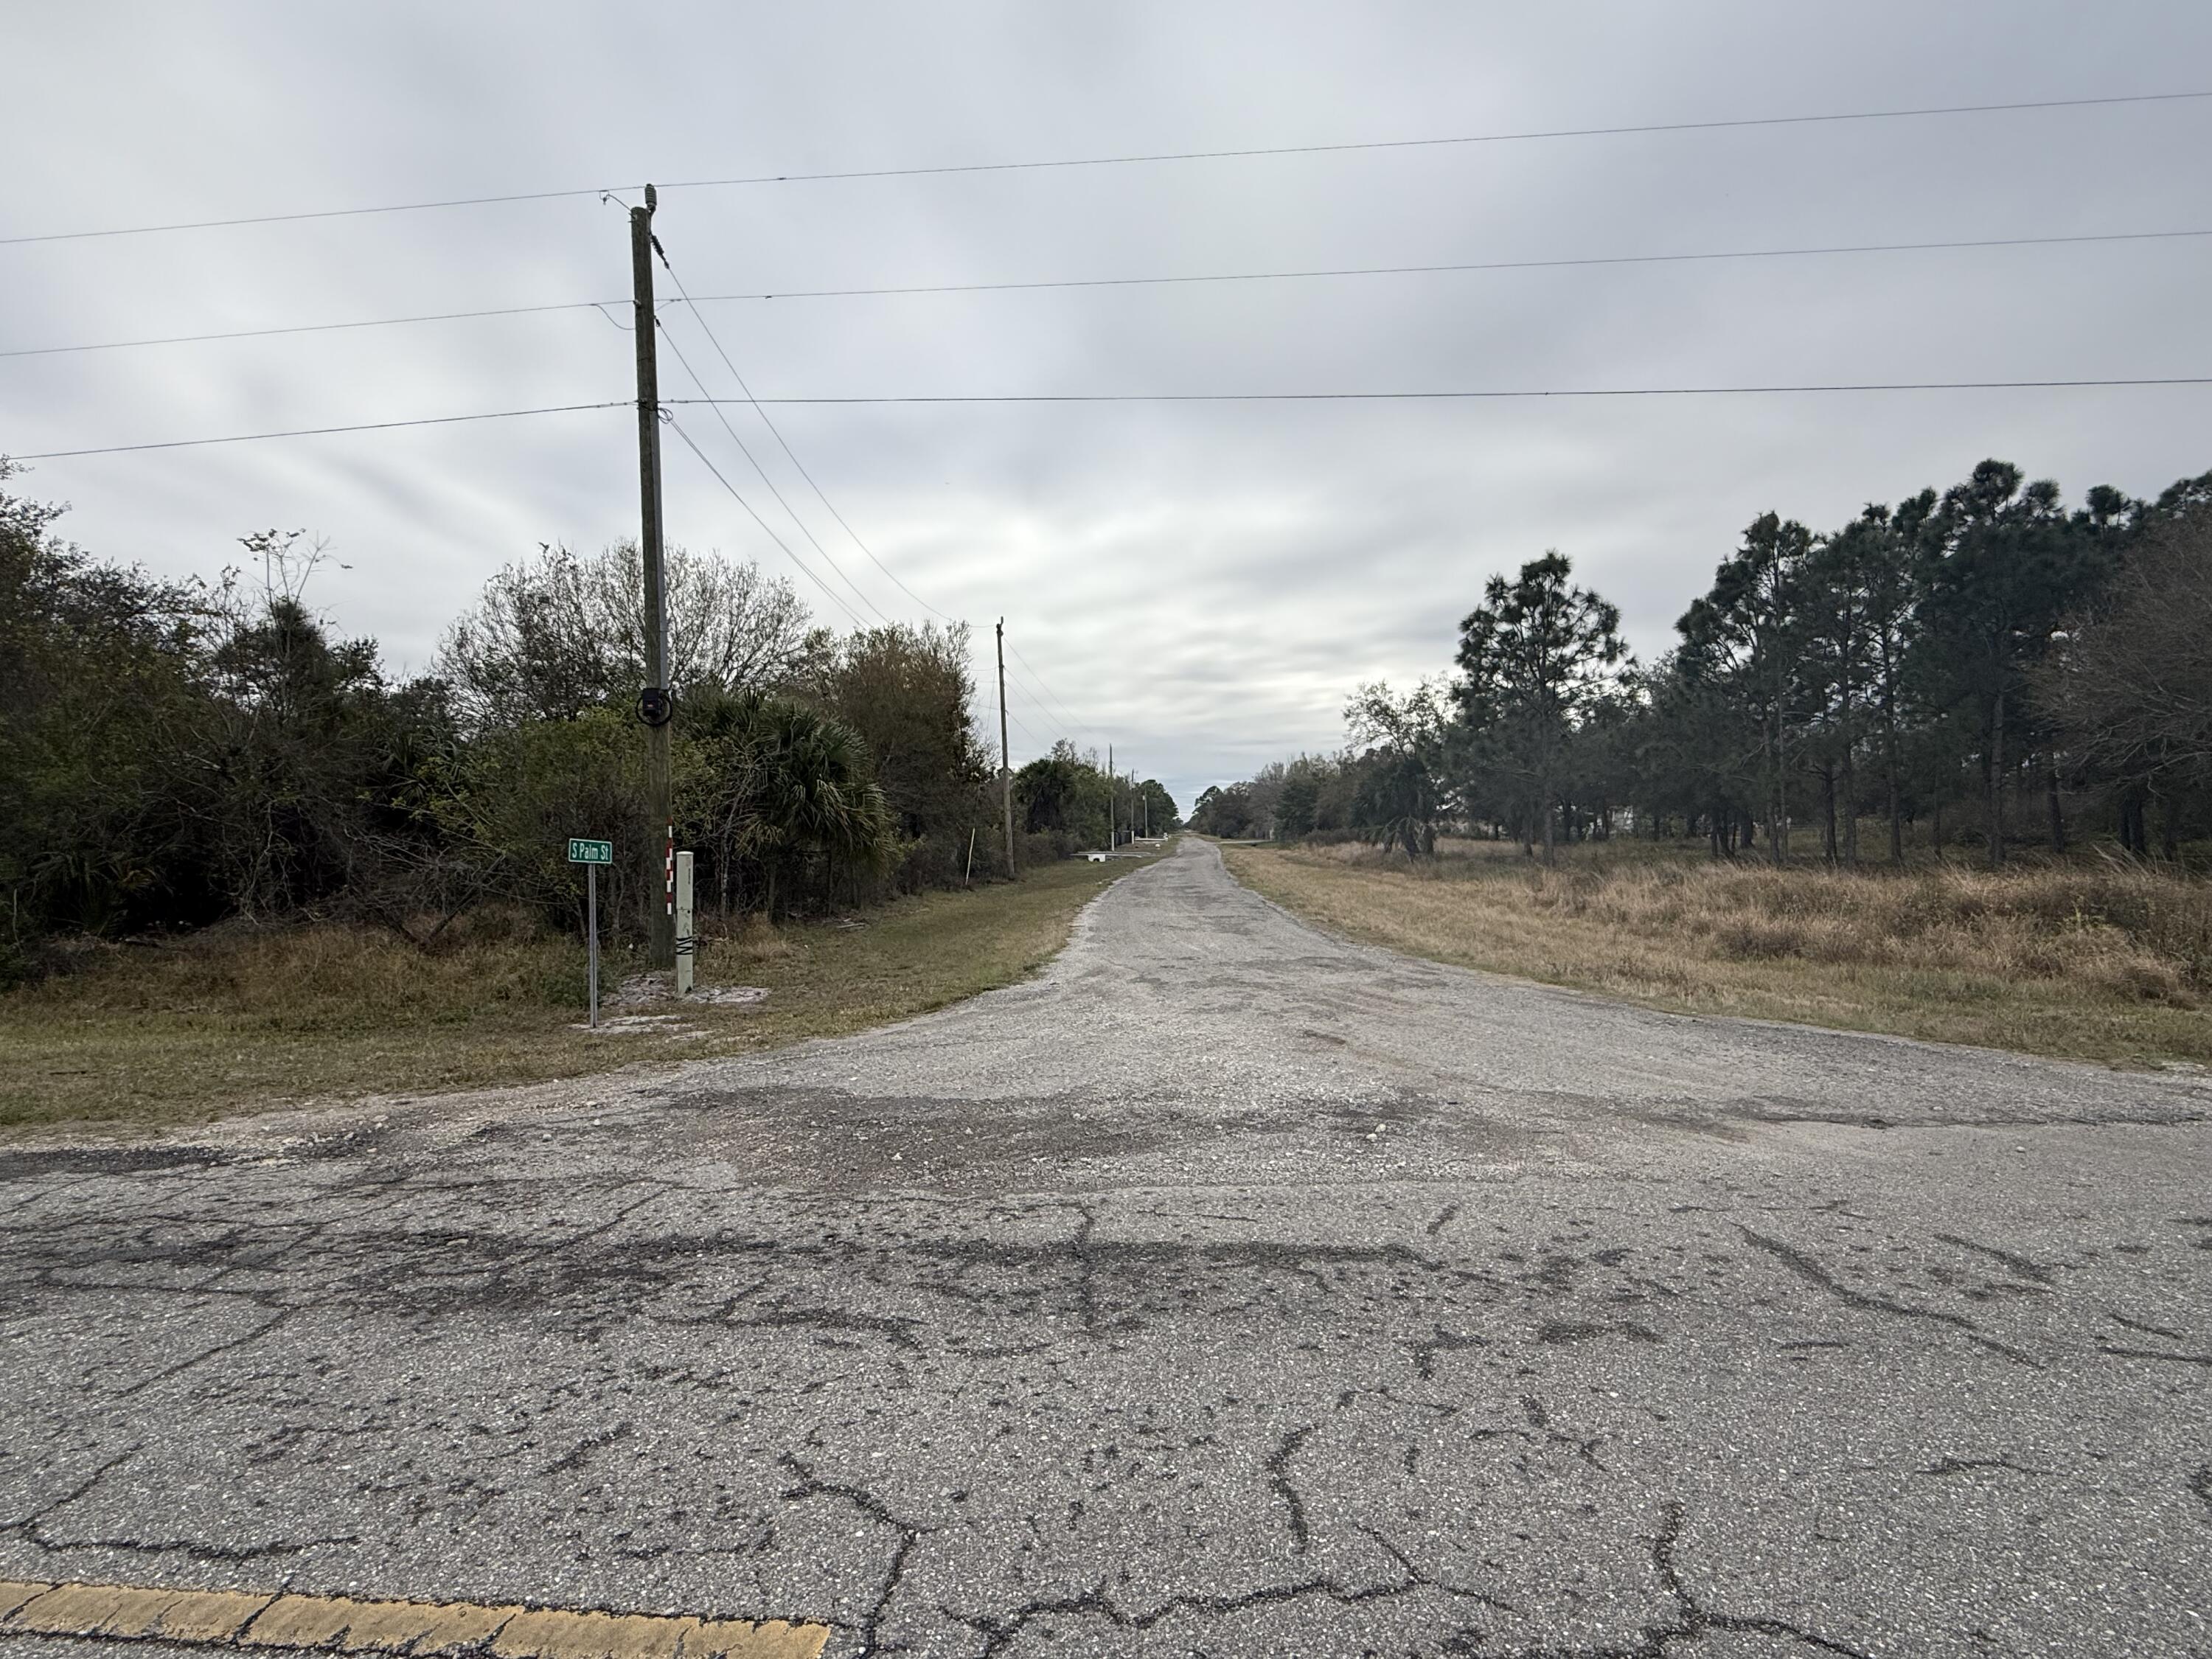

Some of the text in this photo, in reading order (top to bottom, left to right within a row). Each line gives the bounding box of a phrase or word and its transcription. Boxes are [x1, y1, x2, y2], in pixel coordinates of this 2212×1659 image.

[572, 843, 608, 860] S Palm St
